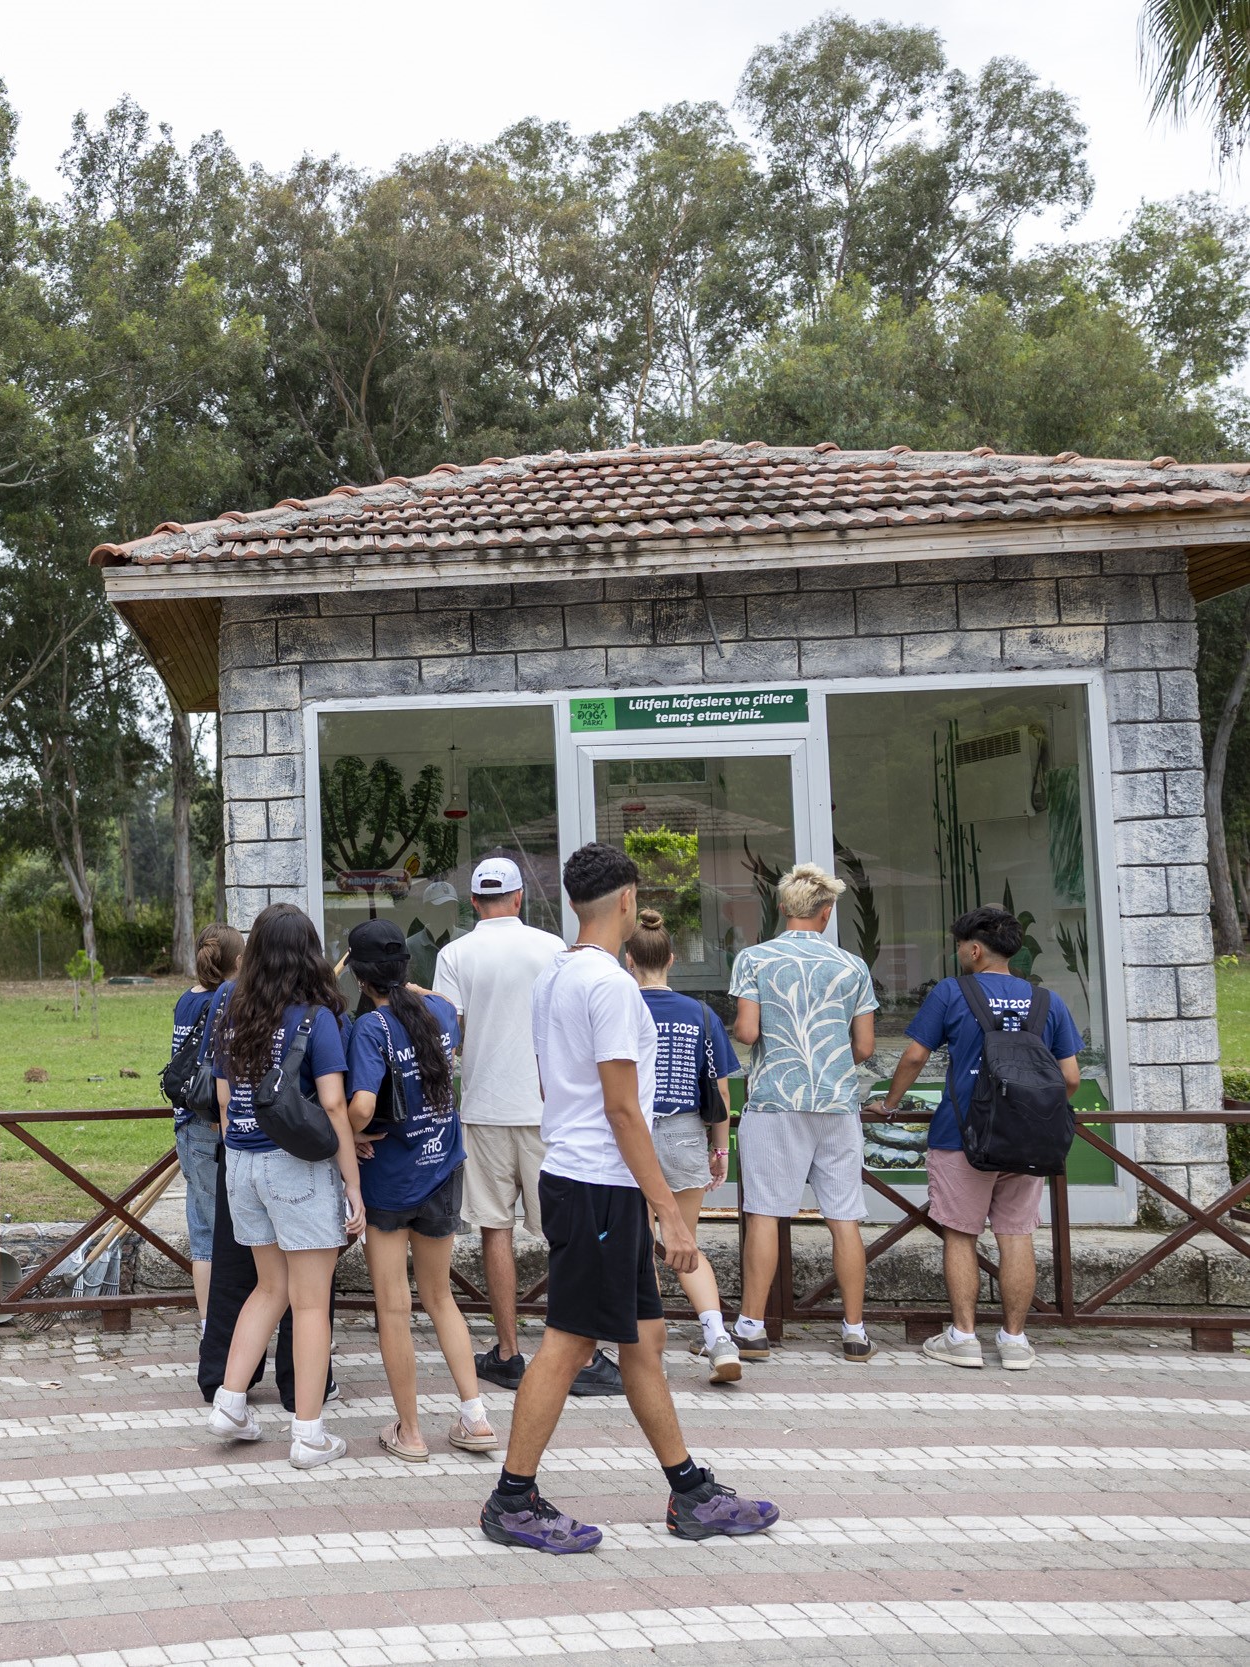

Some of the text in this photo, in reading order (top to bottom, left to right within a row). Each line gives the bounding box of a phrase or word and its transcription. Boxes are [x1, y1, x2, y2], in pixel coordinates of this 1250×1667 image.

[629, 694, 793, 711] Lütfen kafeslere ve çitlere
[655, 709, 764, 722] temas etmeyiniz.
[1010, 999, 1031, 1008] 202
[672, 1023, 699, 1036] 2025
